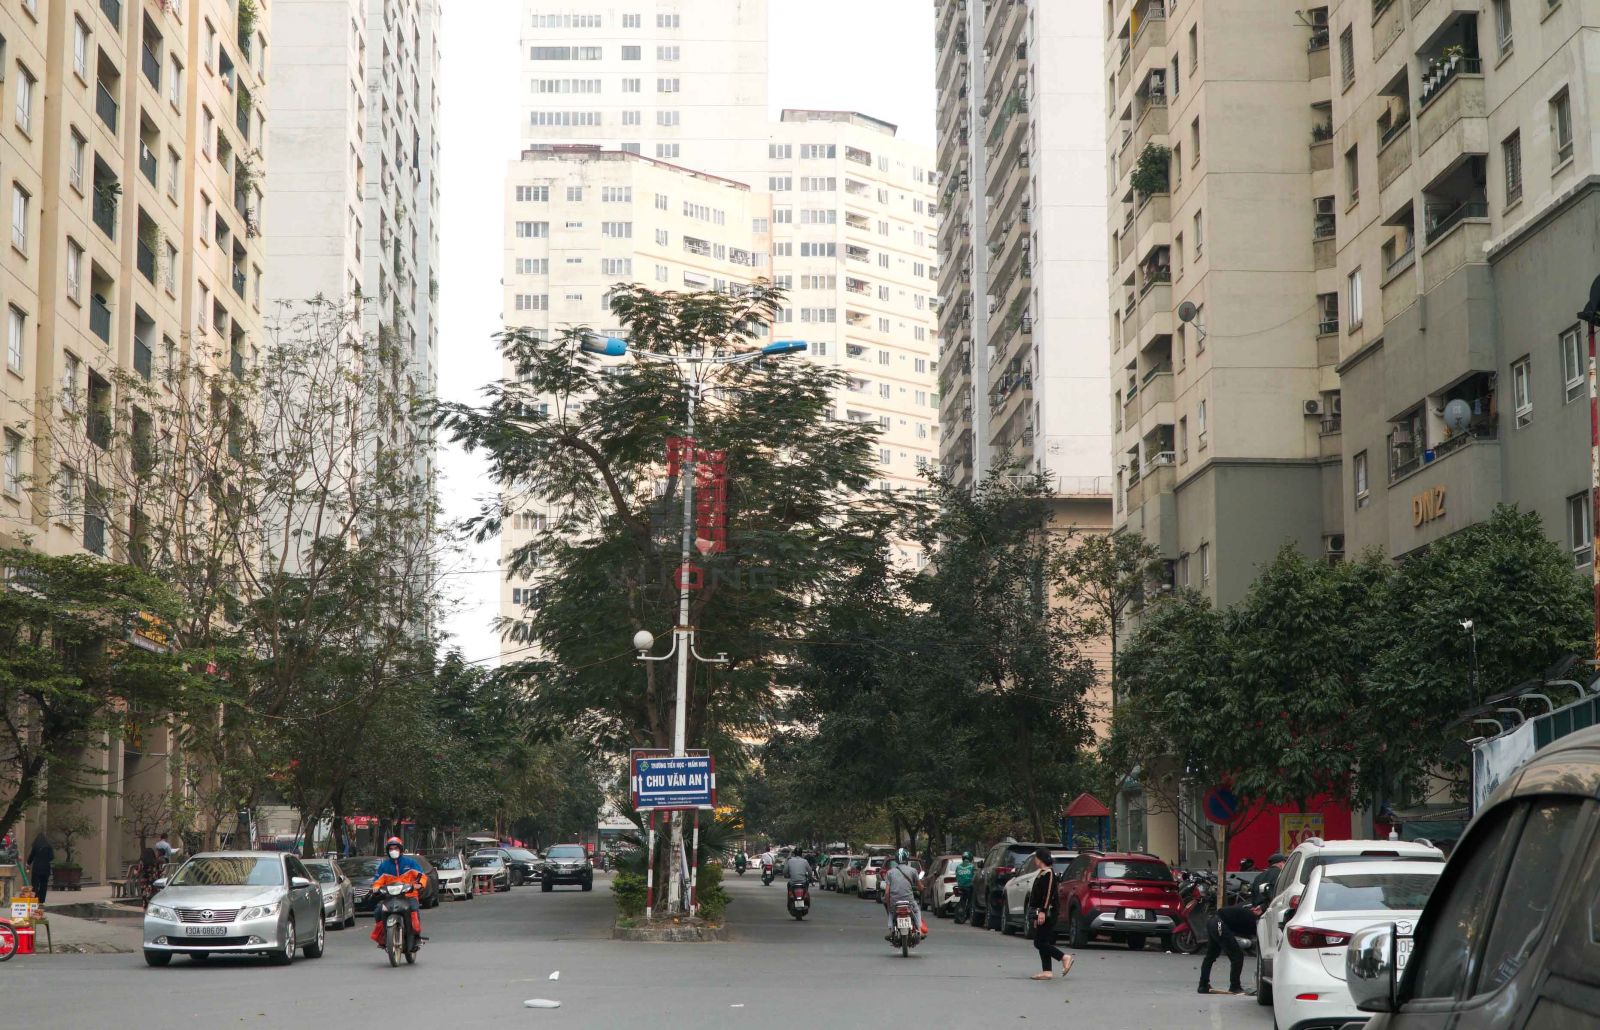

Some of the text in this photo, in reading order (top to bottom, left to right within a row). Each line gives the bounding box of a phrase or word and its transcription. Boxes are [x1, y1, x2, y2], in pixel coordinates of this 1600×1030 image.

[1411, 485, 1446, 526] DN2
[646, 772, 702, 787] CHU VĂN AN
